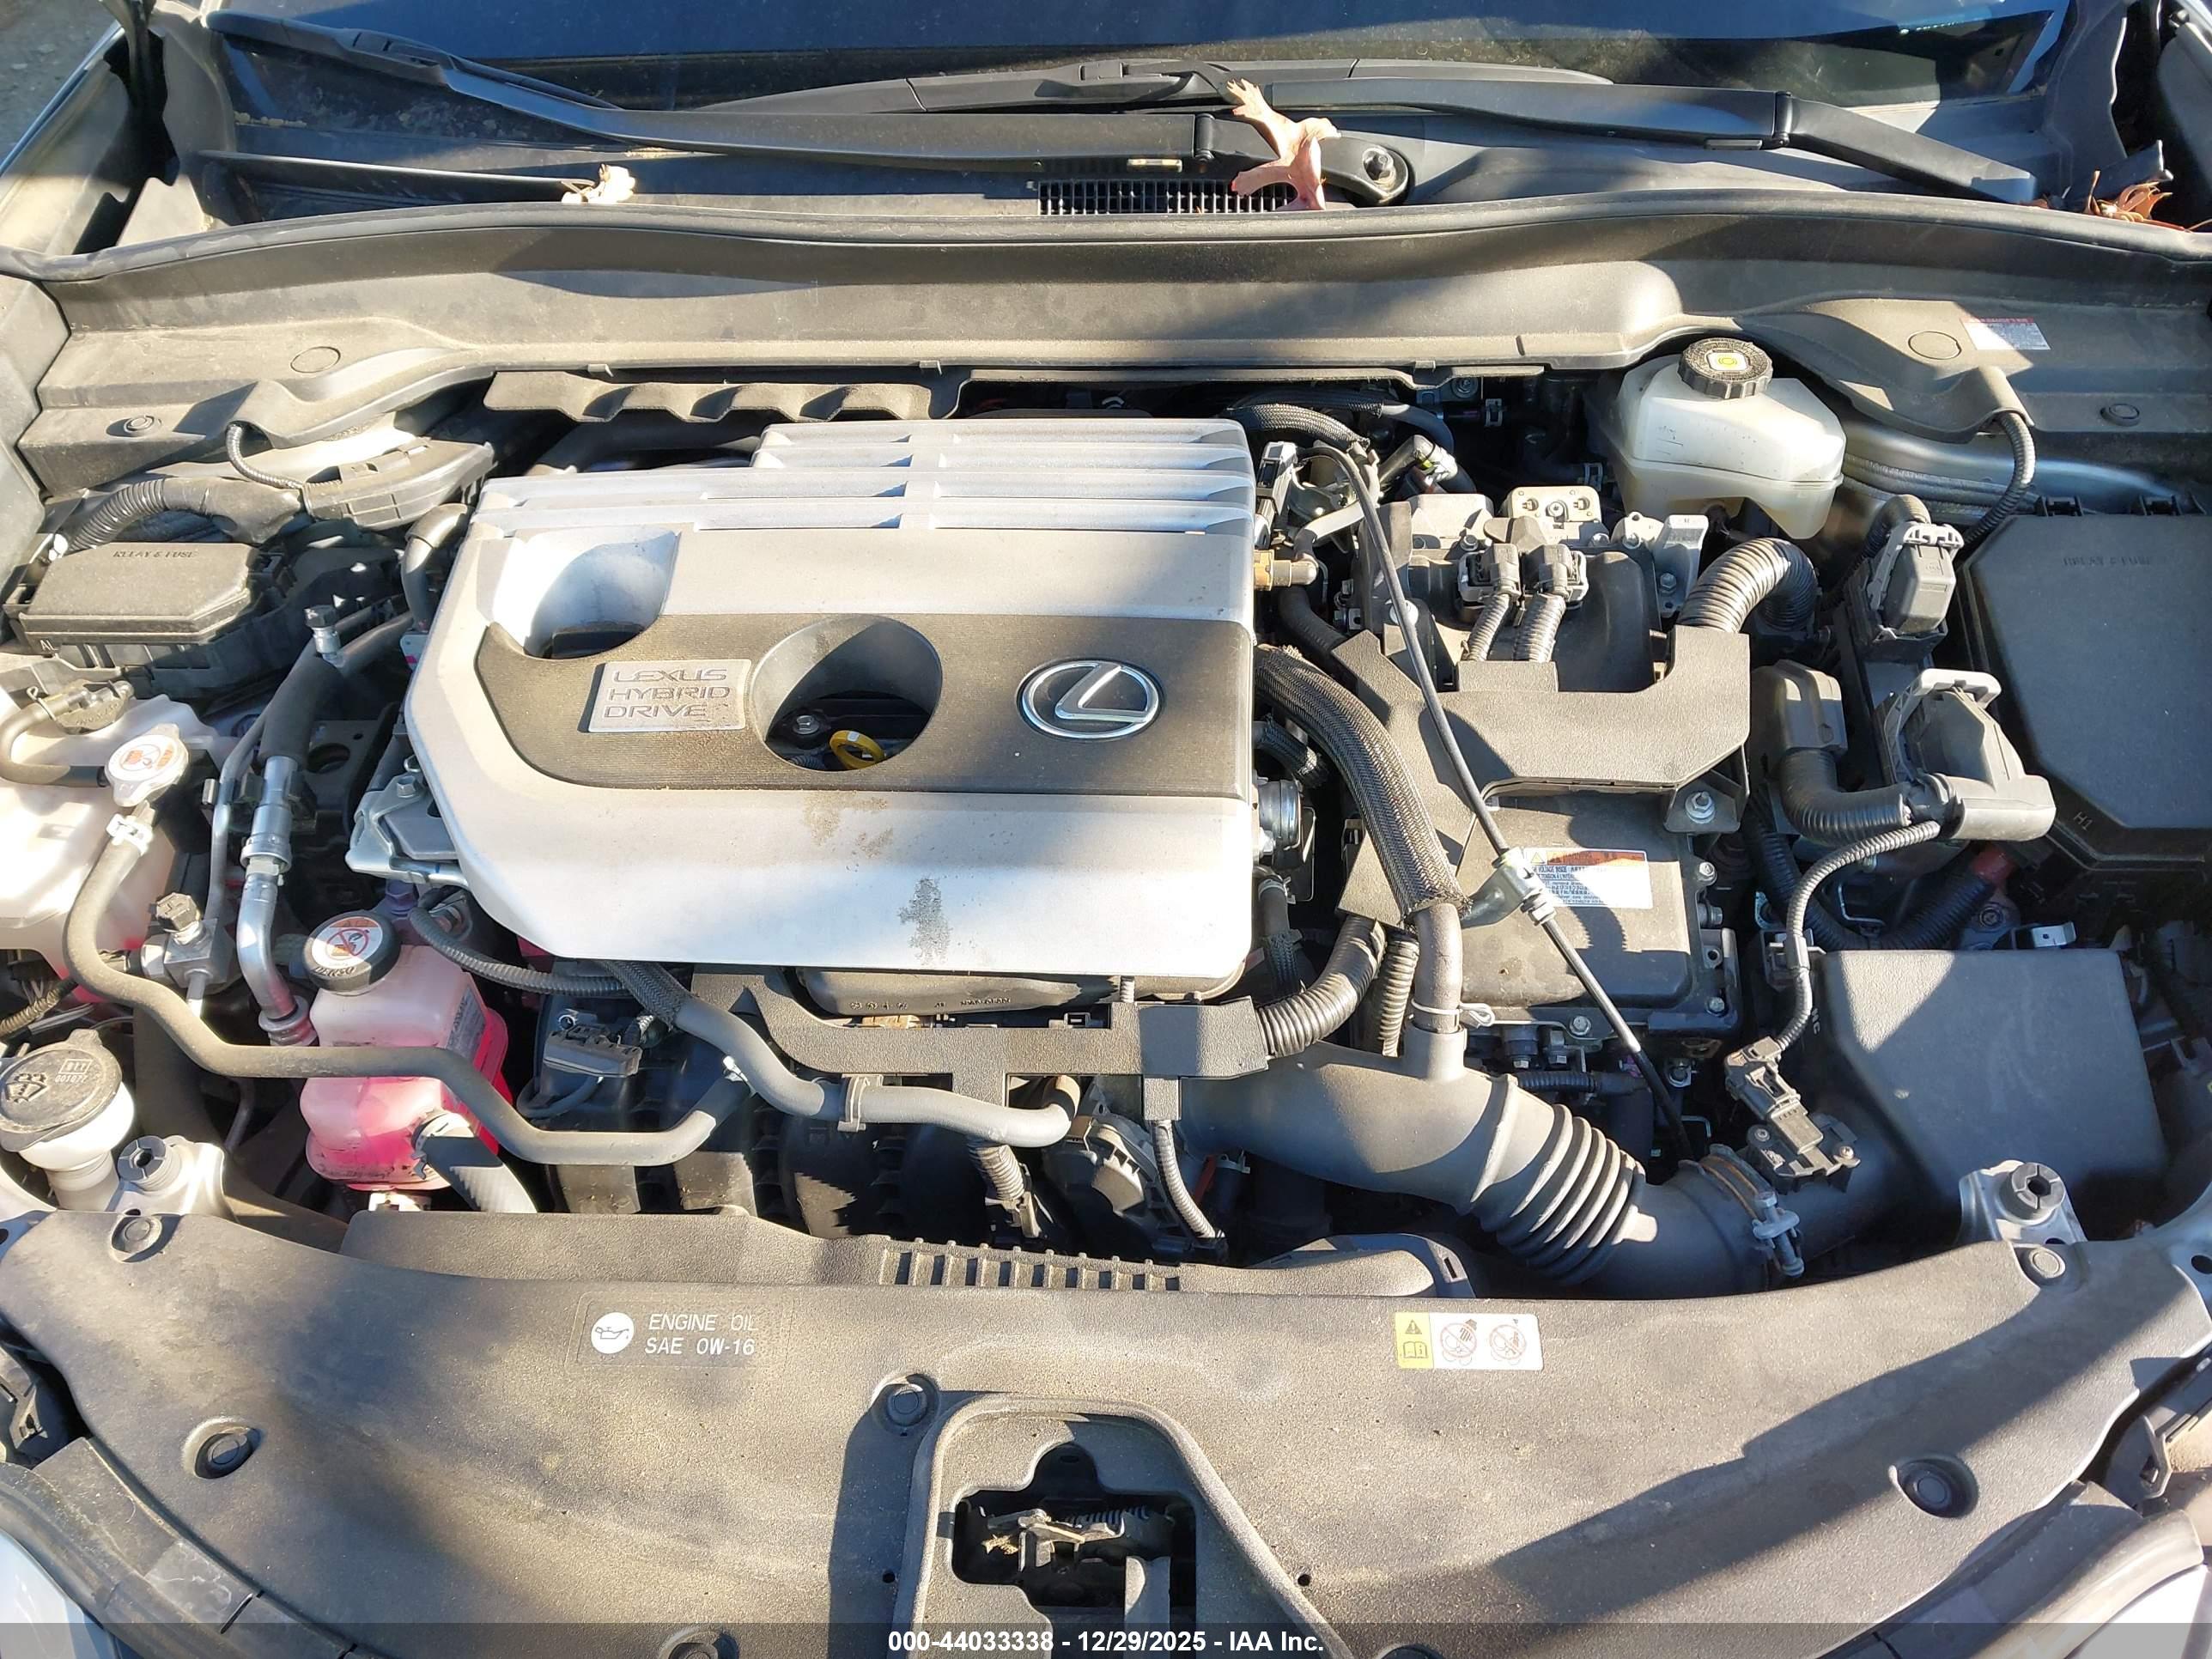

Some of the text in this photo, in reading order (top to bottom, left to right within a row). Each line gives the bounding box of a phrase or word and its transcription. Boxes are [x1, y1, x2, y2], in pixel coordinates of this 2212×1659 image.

[613, 669, 727, 683] LEXUS
[607, 686, 731, 701] HYBRID
[603, 704, 707, 719] DRIVE
[648, 1314, 759, 1332] ENGINE OIL
[644, 1337, 756, 1356] SAE 0W-16
